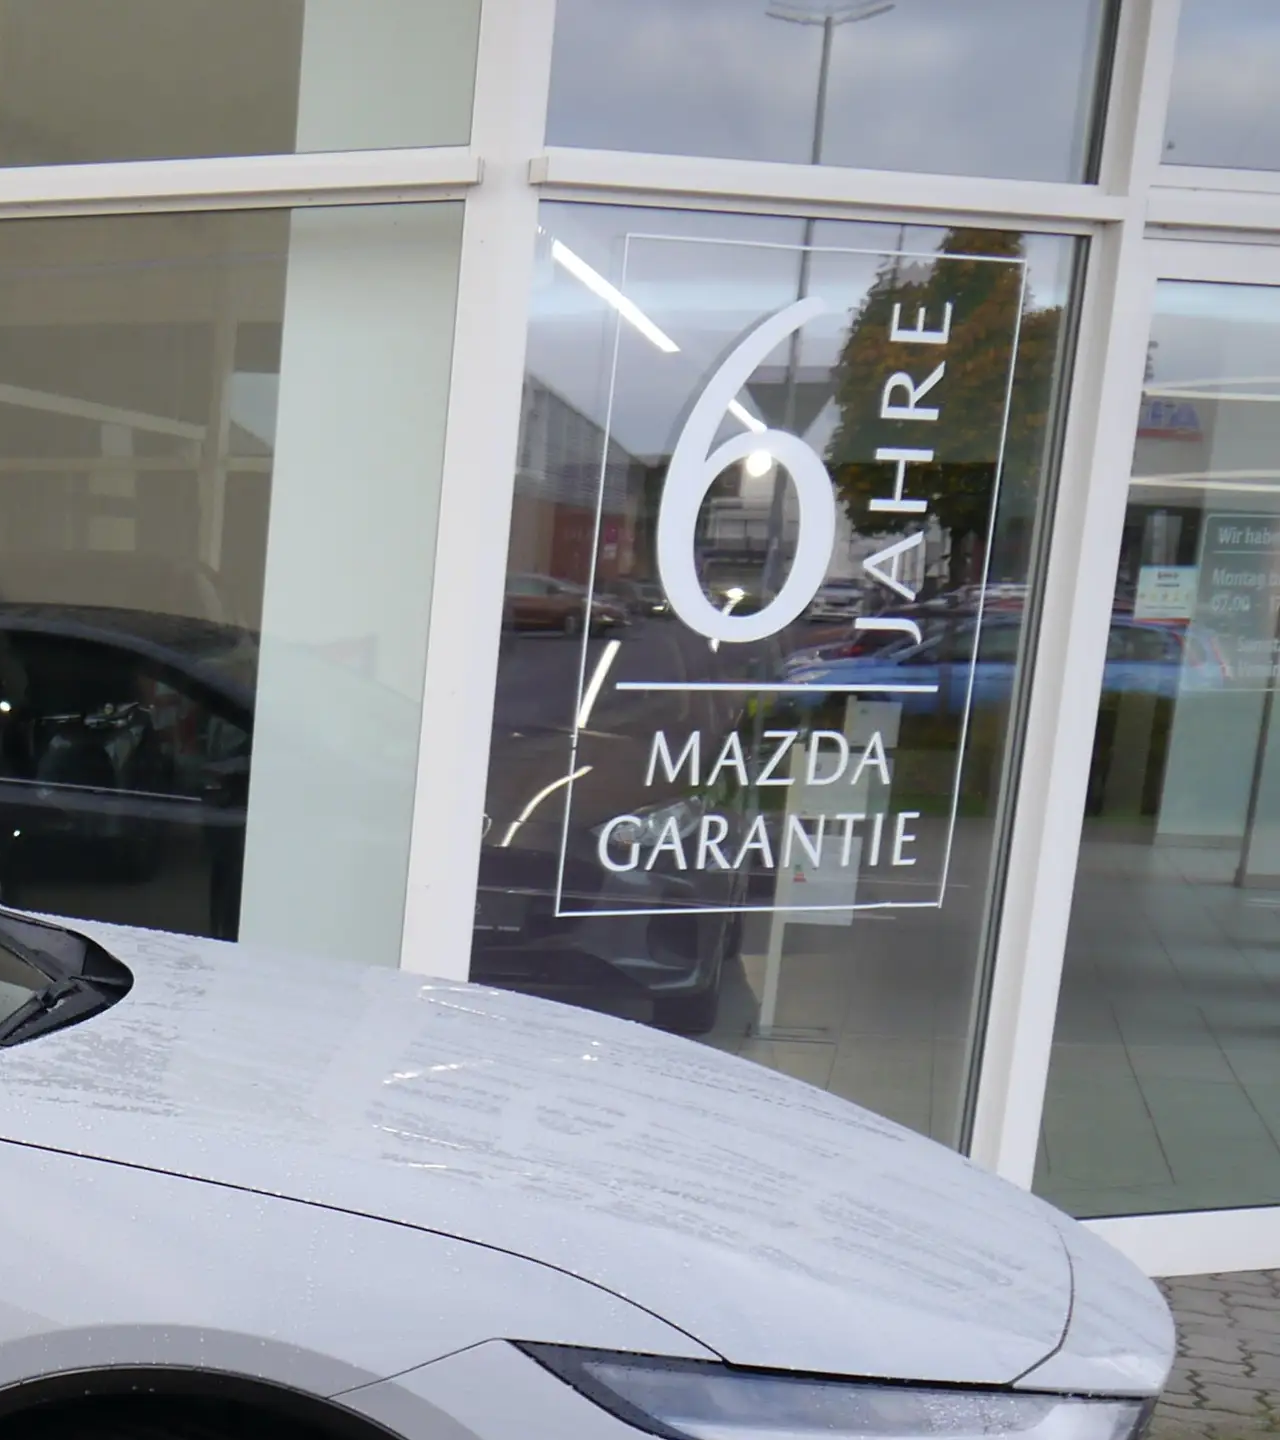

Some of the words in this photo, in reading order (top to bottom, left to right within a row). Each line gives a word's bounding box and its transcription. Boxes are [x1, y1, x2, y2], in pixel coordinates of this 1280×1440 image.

[657, 296, 836, 643] 6
[854, 302, 952, 645] JAHRE
[1218, 527, 1241, 544] Wir
[1244, 527, 1280, 545] hab
[644, 729, 892, 786] MAZDA
[597, 812, 920, 872] GARANTIE
